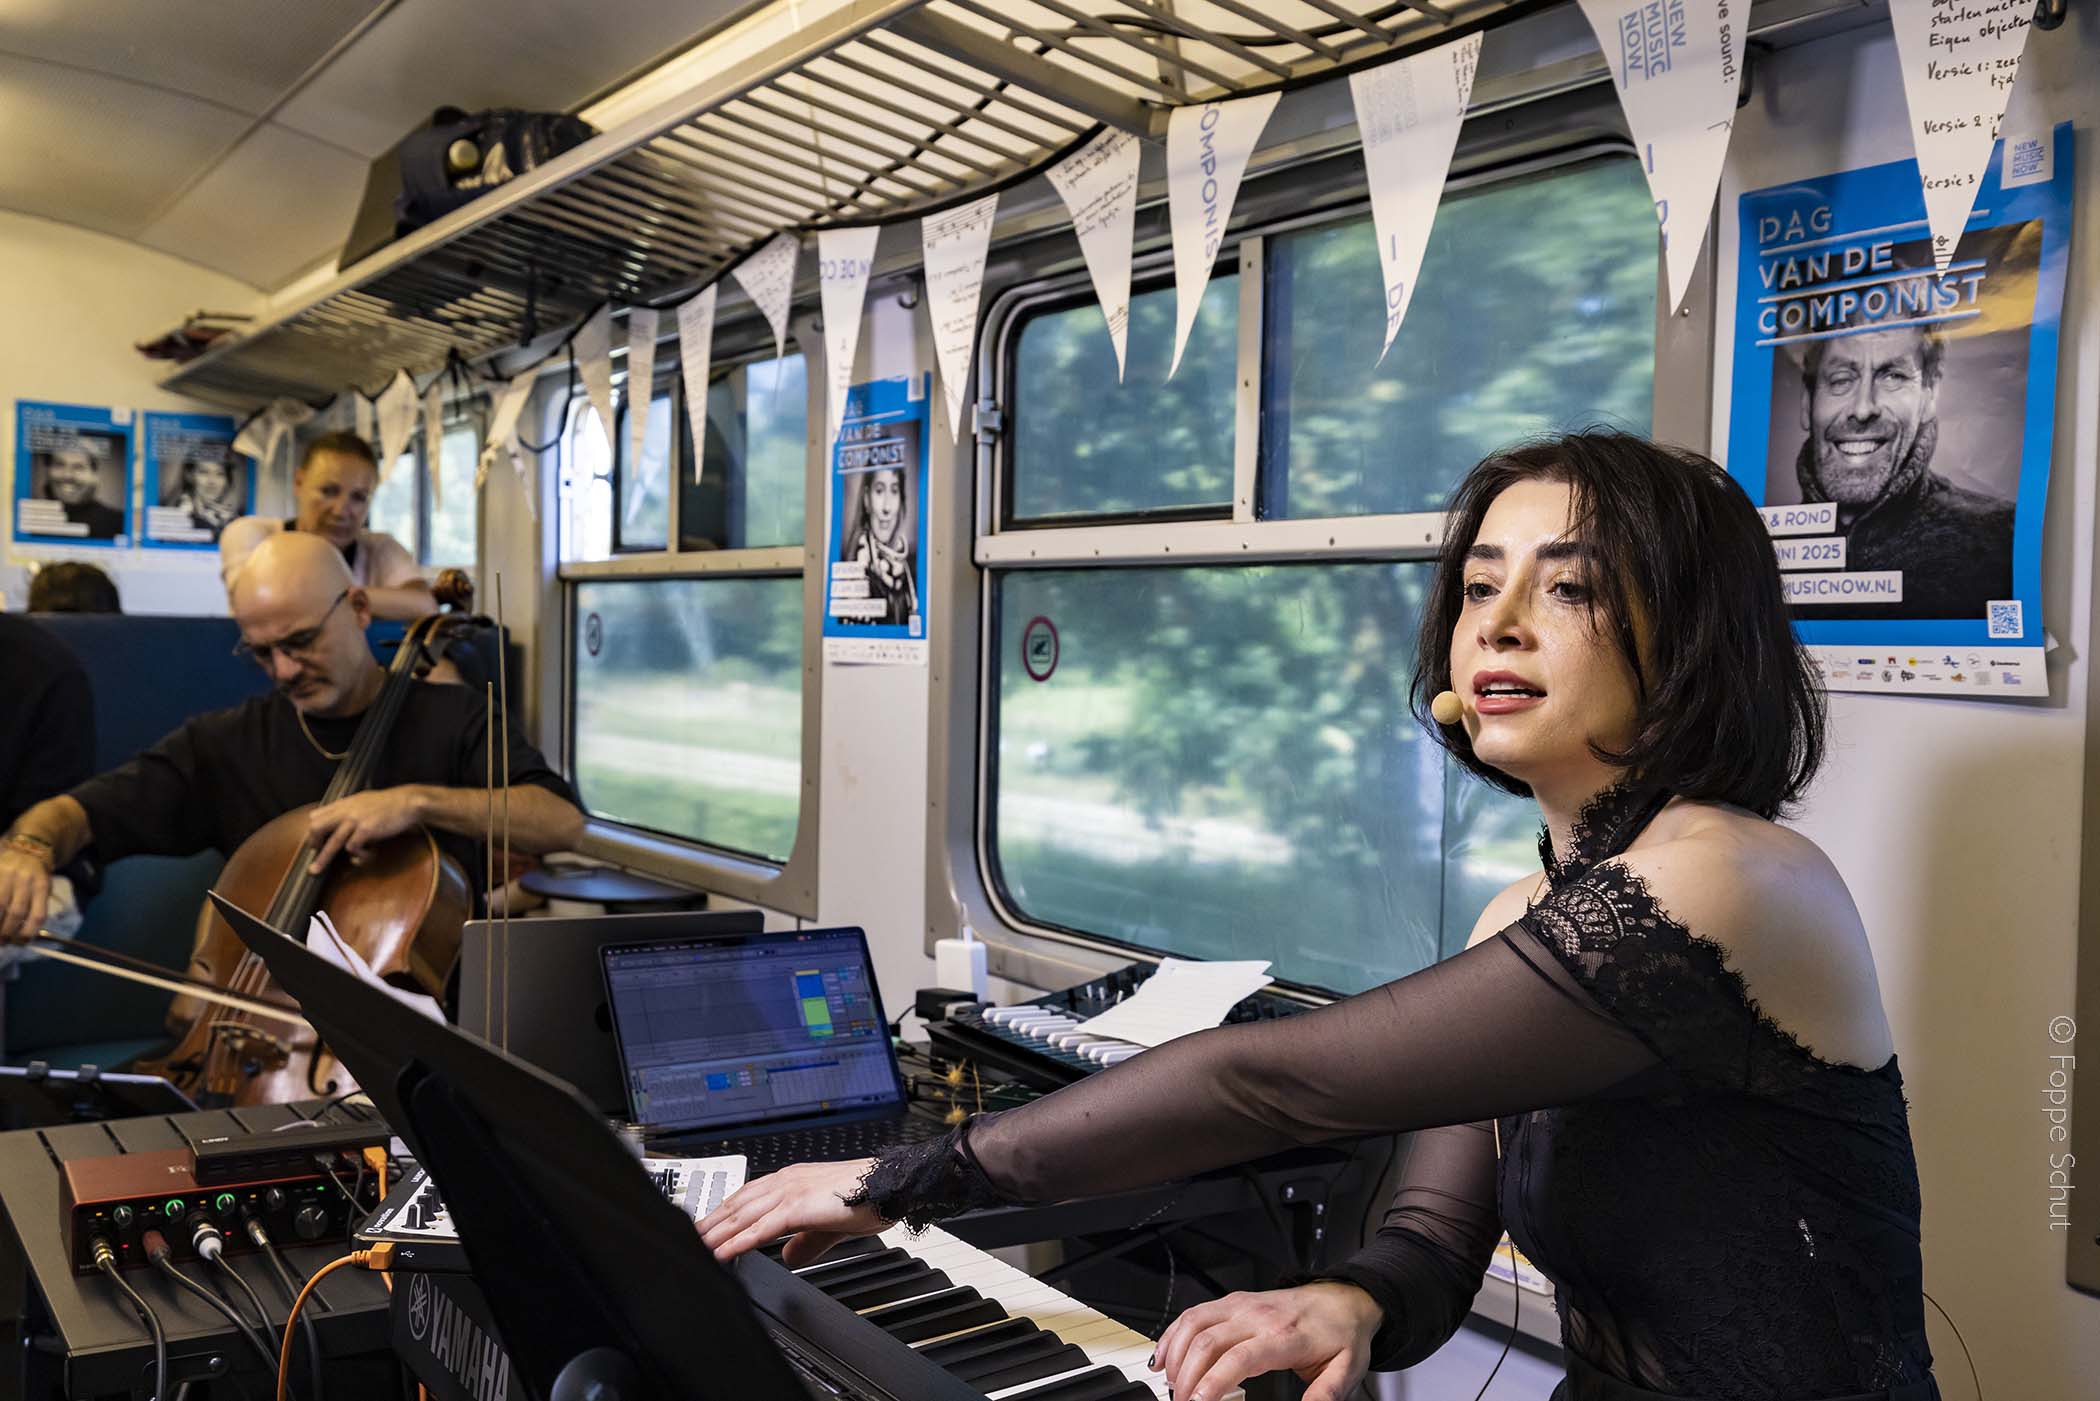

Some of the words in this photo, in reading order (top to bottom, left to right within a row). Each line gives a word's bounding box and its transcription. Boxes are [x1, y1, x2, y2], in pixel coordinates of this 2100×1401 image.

[1624, 11, 1644, 71] NOW
[1646, 2, 1666, 78] MUSIC
[1668, 0, 1686, 47] NEW
[1719, 24, 1737, 84] sound:
[1927, 60, 1973, 81] Versie
[1923, 118, 1968, 135] Versie
[1759, 205, 1834, 245] DAG
[1758, 250, 1831, 290] VAN
[1843, 240, 1894, 275] DE
[1757, 270, 1987, 335] COMPONIST
[1770, 513, 1780, 528] &
[1784, 509, 1832, 527] ROND
[1801, 543, 1841, 561] 2025
[430, 1284, 510, 1401] YAMAHA
